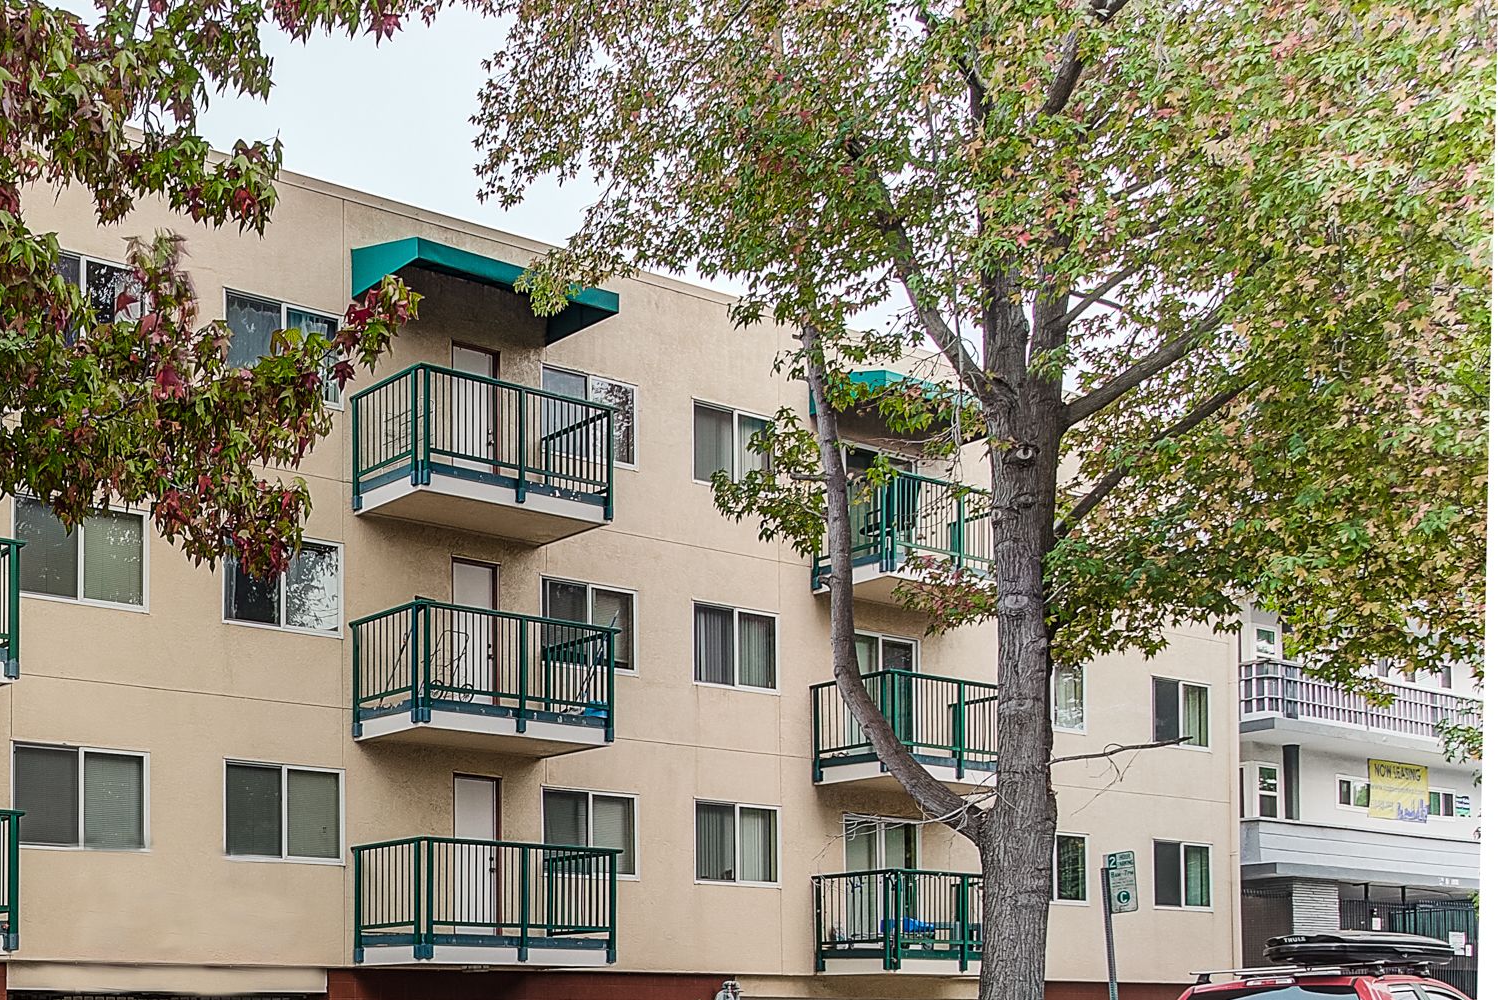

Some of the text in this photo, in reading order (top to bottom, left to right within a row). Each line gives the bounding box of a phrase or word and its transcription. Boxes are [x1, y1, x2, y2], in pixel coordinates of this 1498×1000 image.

[1374, 764, 1421, 781] NOW LEASING
[1109, 856, 1117, 868] 2
